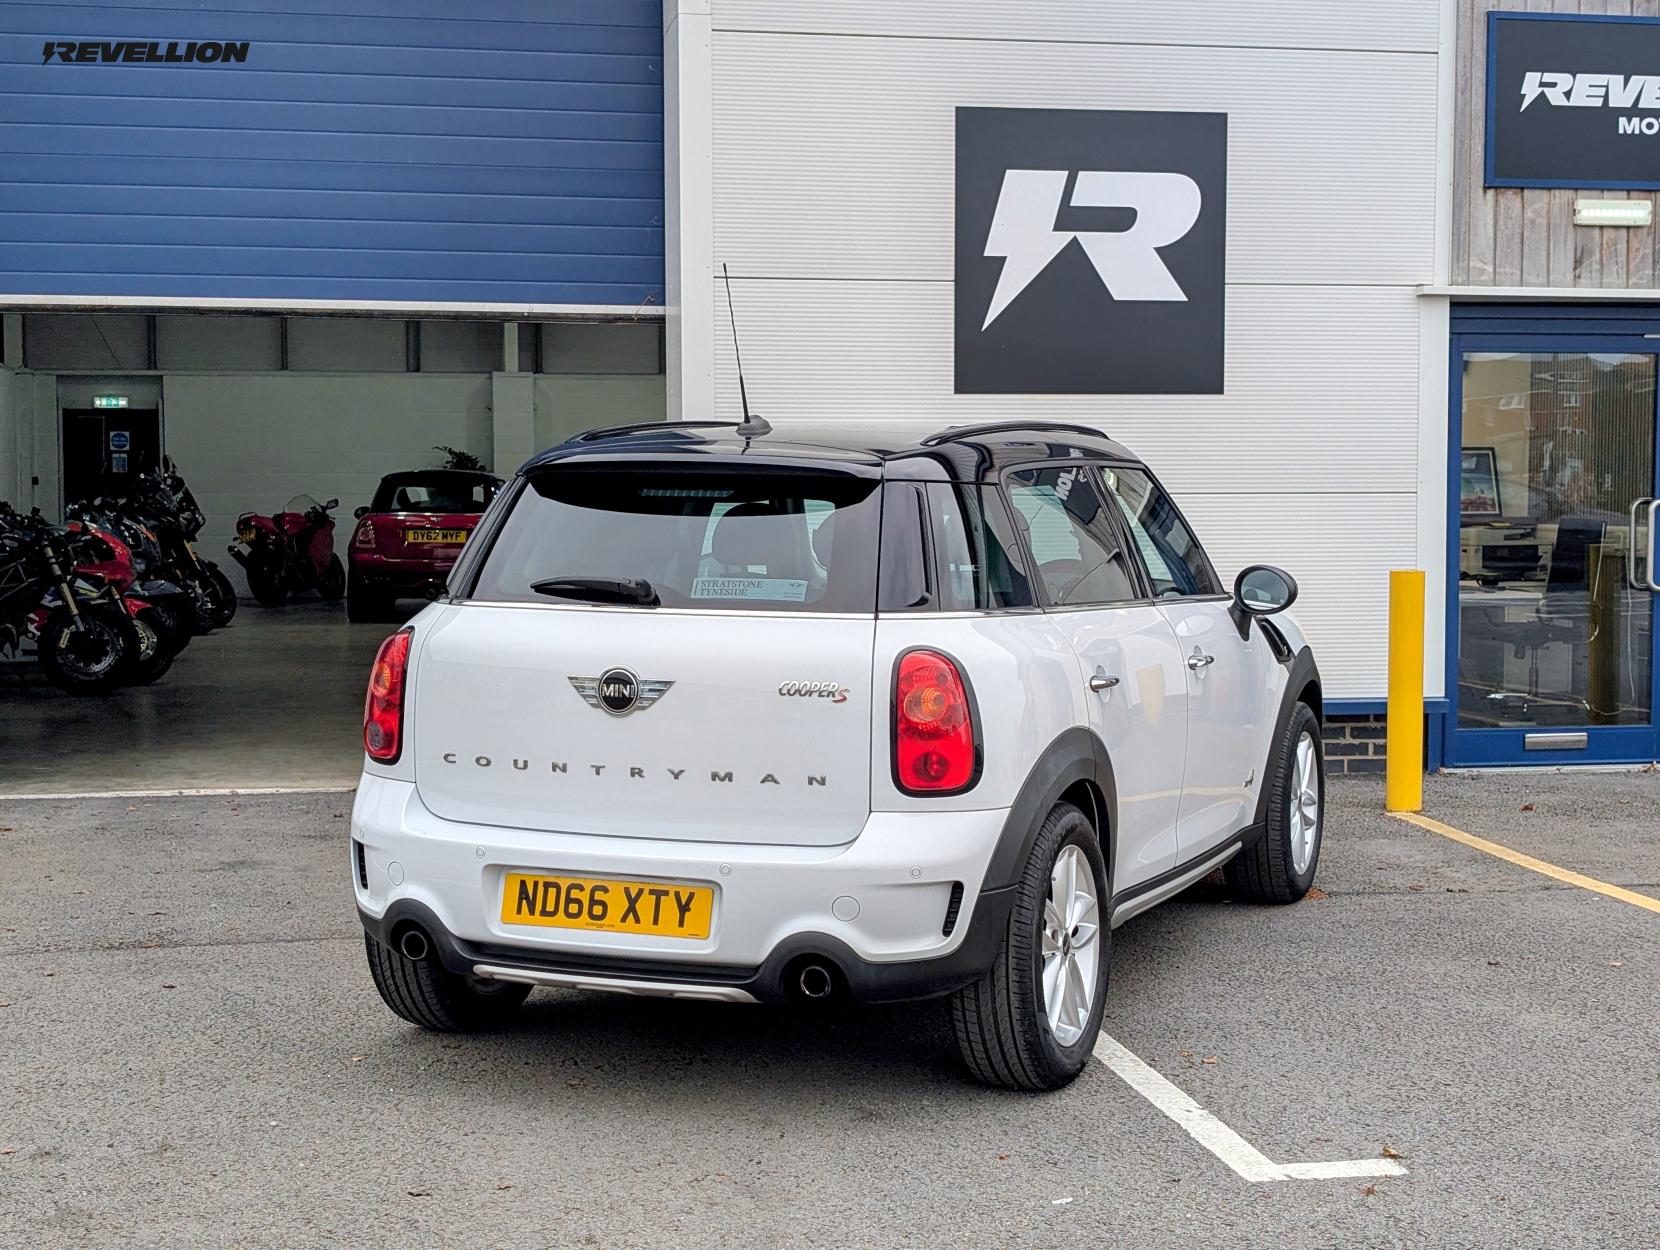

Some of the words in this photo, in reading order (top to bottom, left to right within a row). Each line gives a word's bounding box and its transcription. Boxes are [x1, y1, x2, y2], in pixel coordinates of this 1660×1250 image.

[1618, 117, 1660, 134] MO
[413, 531, 439, 541] DY62
[700, 580, 763, 589] STRATSTONE
[700, 588, 748, 597] TYNESIDE
[602, 684, 634, 697] MINI
[442, 752, 828, 786] COUNTRYMAN
[516, 879, 610, 922] ND66
[619, 886, 696, 928] XTY
